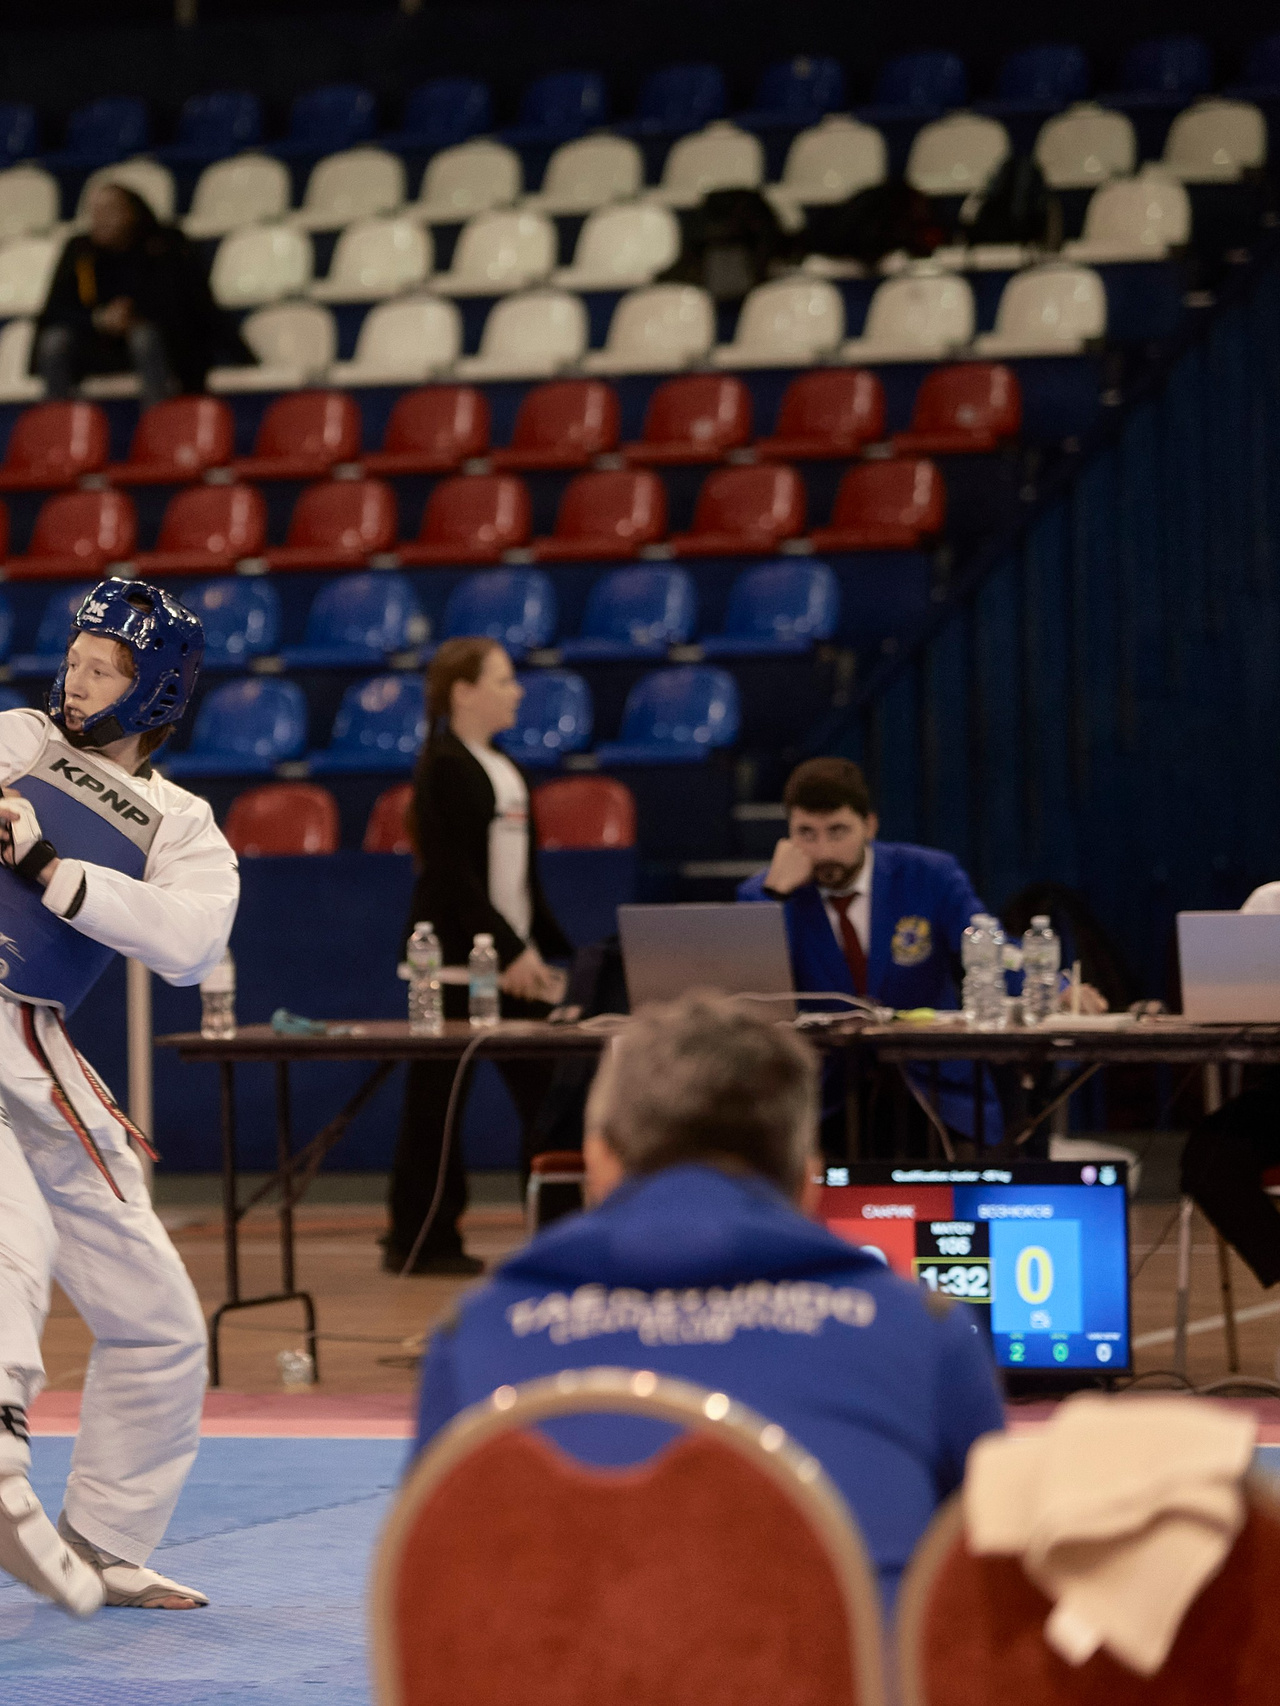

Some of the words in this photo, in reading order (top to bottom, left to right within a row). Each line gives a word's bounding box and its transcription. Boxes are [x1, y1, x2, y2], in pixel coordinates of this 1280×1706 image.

[48, 757, 150, 827] KPNP
[920, 1265, 989, 1297] 1:32
[1015, 1245, 1054, 1304] 0
[1009, 1342, 1025, 1362] 2
